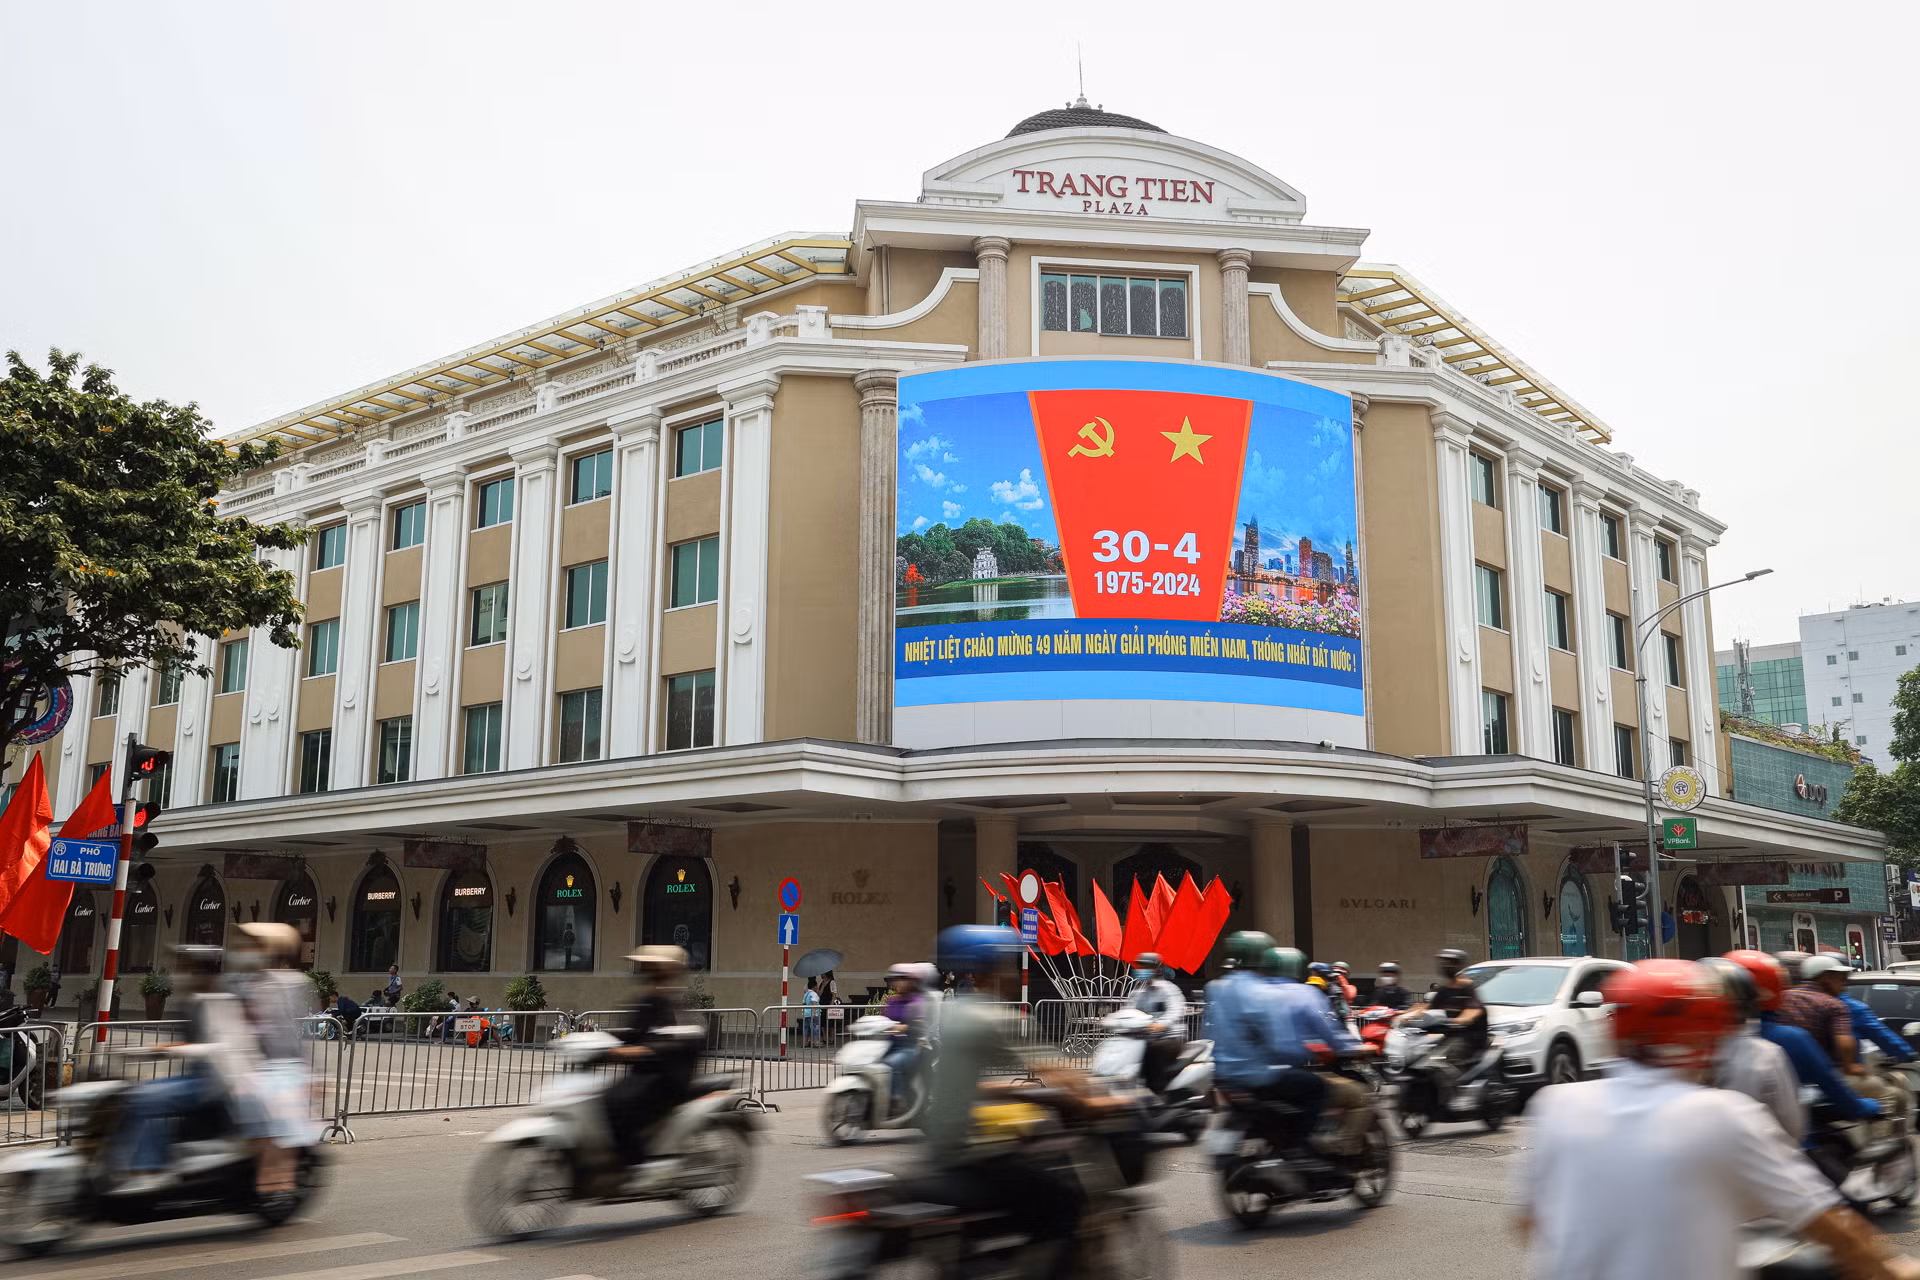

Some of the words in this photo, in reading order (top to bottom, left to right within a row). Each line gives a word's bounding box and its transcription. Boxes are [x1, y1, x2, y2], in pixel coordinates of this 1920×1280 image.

[1013, 169, 1128, 198] TRANG
[1136, 177, 1215, 203] TIEN
[1083, 200, 1149, 216] PLAZA
[1092, 529, 1201, 565] 30-4
[1094, 570, 1201, 596] 1975-2024
[904, 636, 936, 665] NHIỆT
[938, 634, 961, 663] LIỆT
[963, 632, 994, 658] CHÀO
[997, 630, 1033, 656] MỪNG
[1036, 634, 1051, 655] 49
[1053, 630, 1082, 655] NĂM
[1085, 629, 1118, 655] NGÀY
[1120, 625, 1144, 655] GIẢI
[1147, 630, 1187, 656] PHÓNG
[1190, 629, 1219, 658] MIỀN
[1222, 637, 1250, 662] NAM,
[1251, 634, 1285, 664] THỐNG
[1286, 638, 1311, 666] NHẤT
[1312, 641, 1328, 668] ĐẤT
[1330, 646, 1352, 672] NƯỚC
[79, 845, 101, 856] PHỐ
[53, 859, 69, 875] HAI
[70, 858, 82, 876] BÀ
[84, 861, 112, 878] TRƯNG
[454, 887, 487, 897] BURBERRY
[556, 888, 583, 898] ROLEX
[666, 883, 696, 893] ROLEX
[288, 893, 312, 907] Cartier
[367, 891, 396, 901] BURBERRY
[1834, 890, 1844, 901] P
[200, 898, 221, 911] Cartier
[1340, 898, 1416, 910] BVLGARI
